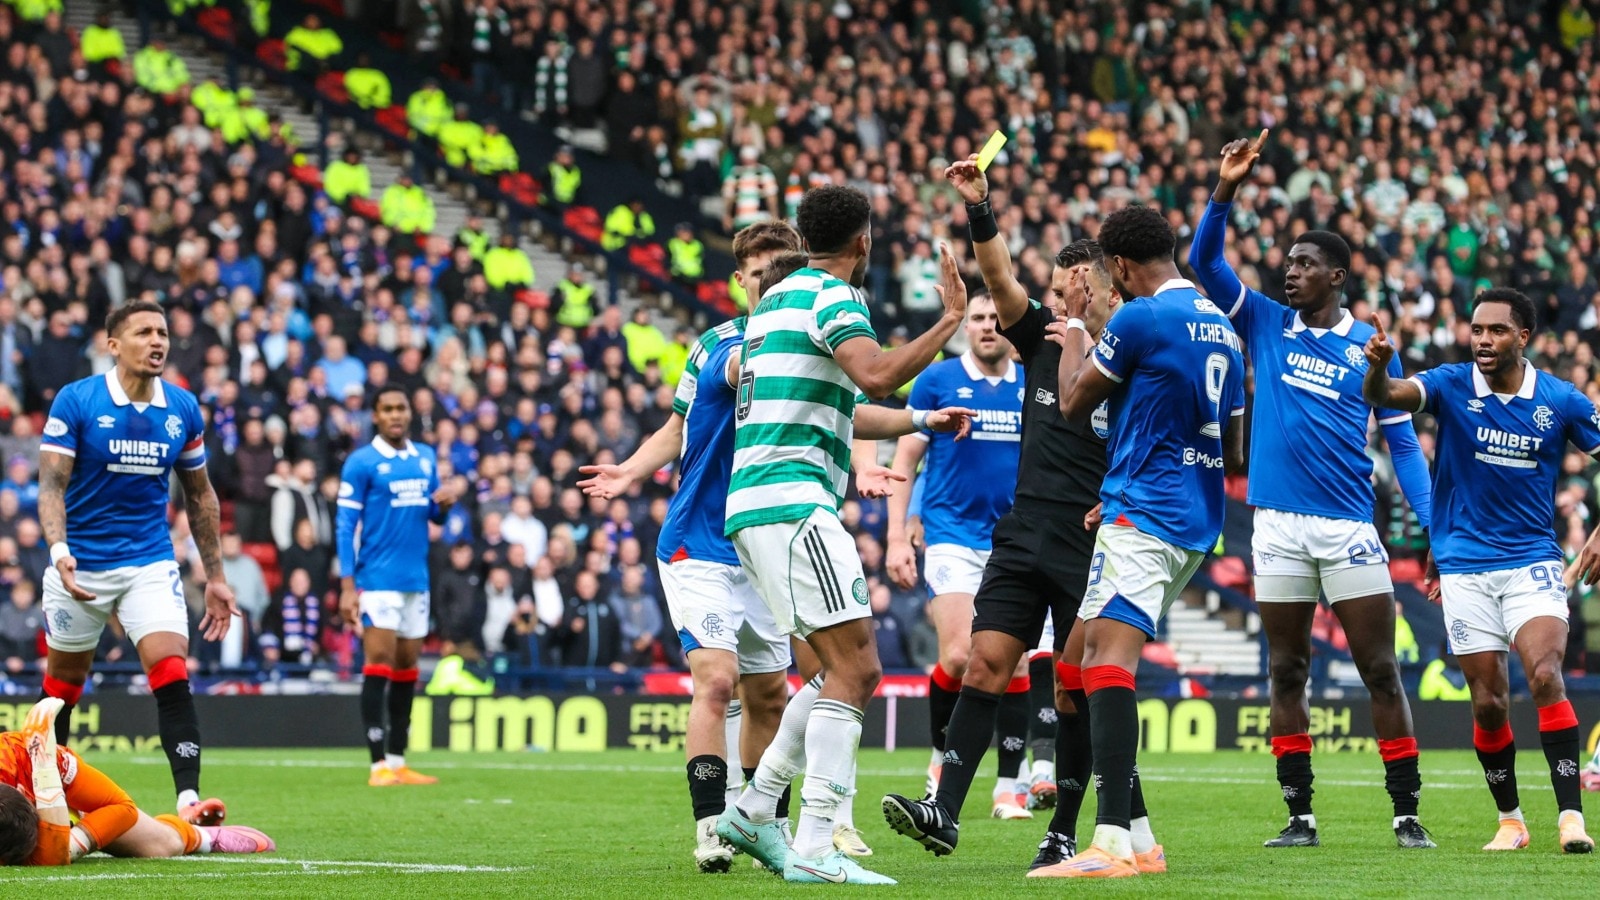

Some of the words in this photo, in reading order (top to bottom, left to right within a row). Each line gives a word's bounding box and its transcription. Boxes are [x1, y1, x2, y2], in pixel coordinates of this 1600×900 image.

[1286, 351, 1350, 382] UNIBET
[108, 439, 170, 458] UNIBET
[1476, 426, 1543, 452] UNIBET
[1348, 539, 1386, 565] 24
[1088, 552, 1106, 587] 9
